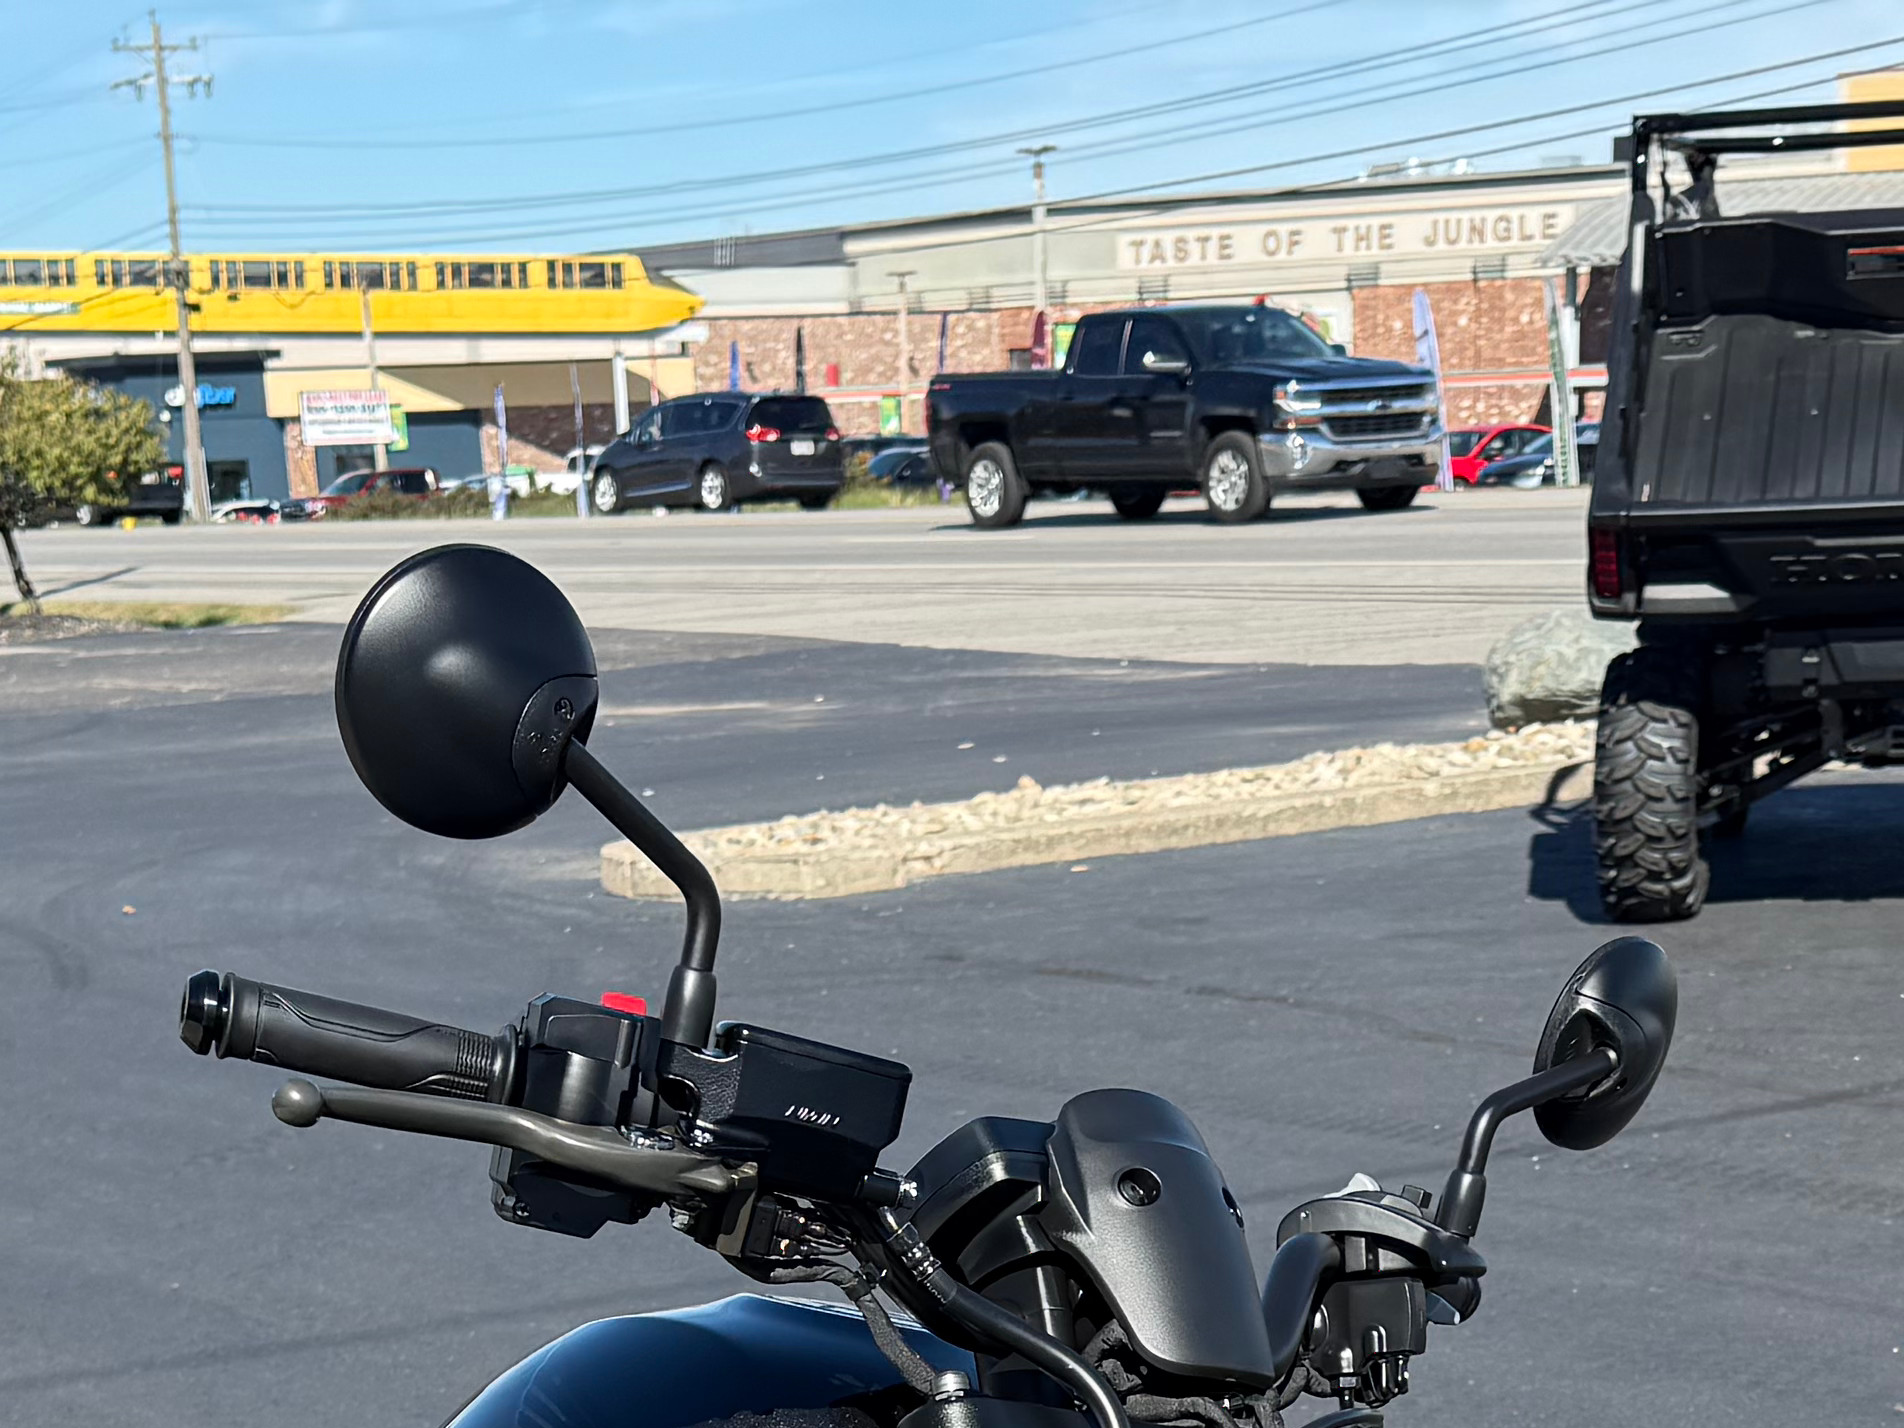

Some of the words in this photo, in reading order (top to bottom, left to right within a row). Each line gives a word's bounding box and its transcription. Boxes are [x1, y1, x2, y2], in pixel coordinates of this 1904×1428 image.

[1129, 233, 1234, 266] TASTE
[1262, 229, 1302, 258] OF
[1331, 223, 1395, 252] THE
[1423, 212, 1561, 248] JUNGLE
